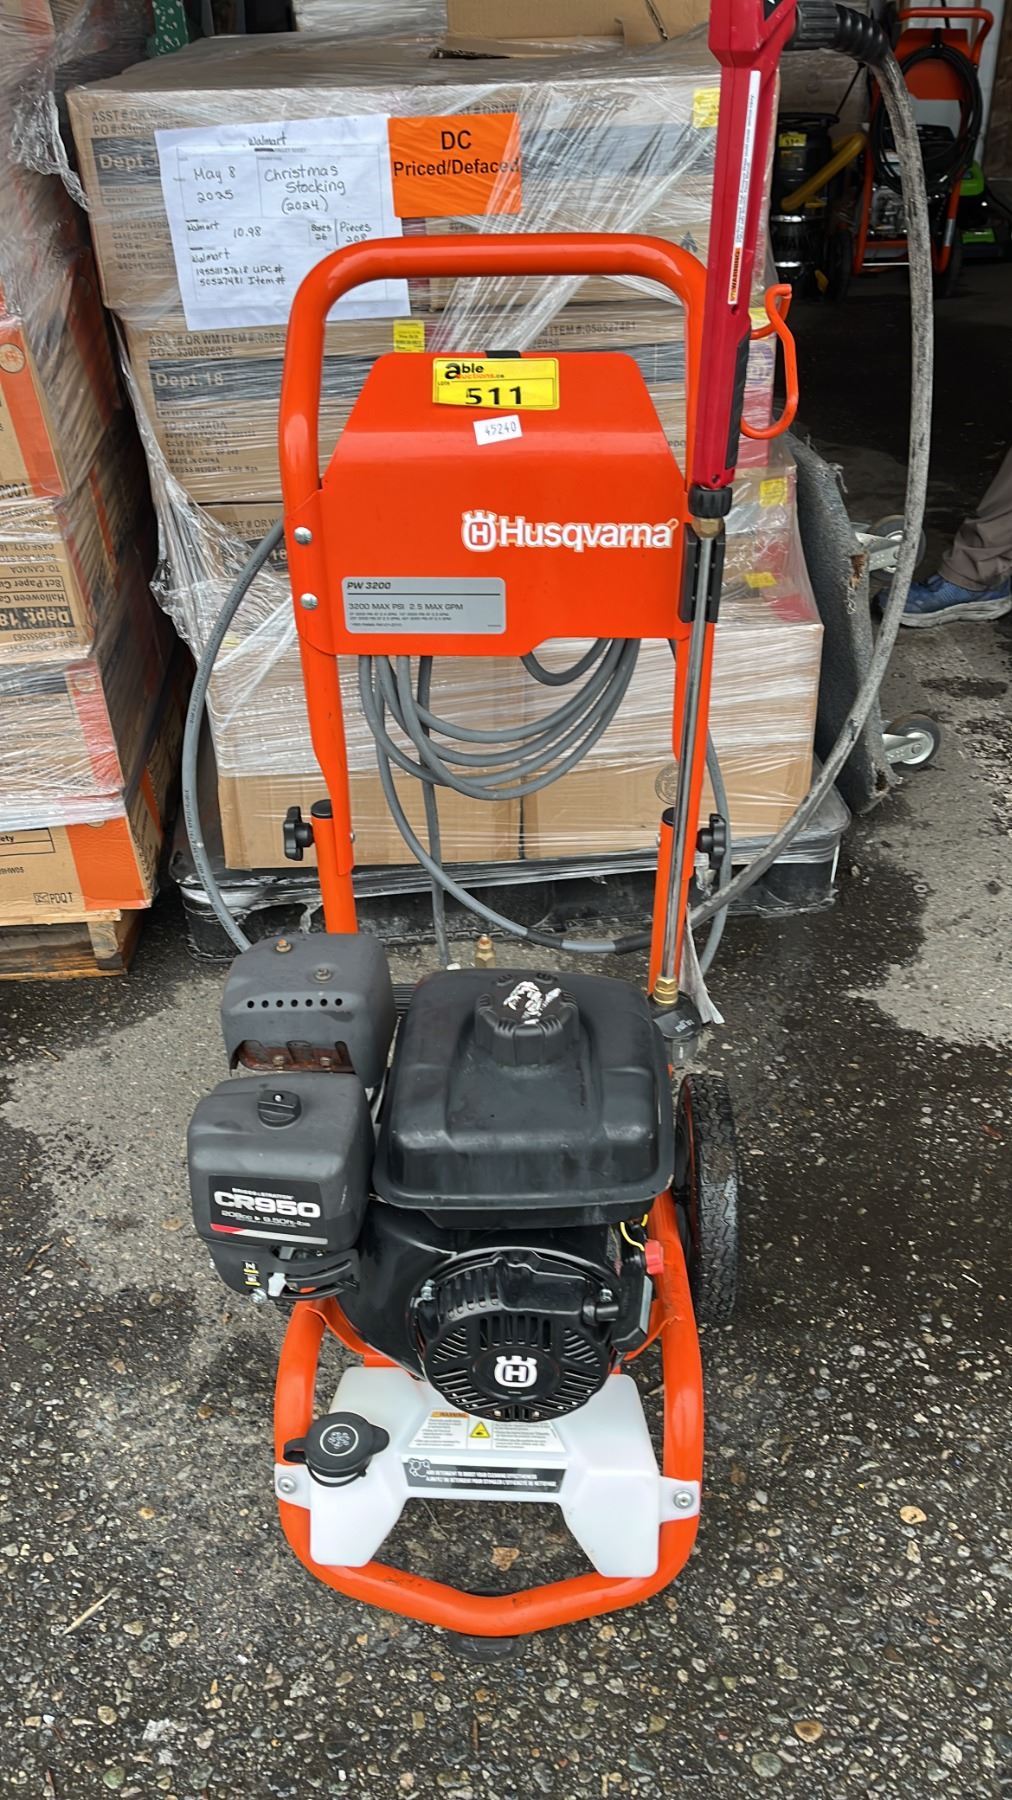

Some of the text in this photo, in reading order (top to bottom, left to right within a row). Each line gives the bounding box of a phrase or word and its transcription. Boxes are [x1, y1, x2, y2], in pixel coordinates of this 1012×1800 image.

[248, 131, 287, 146] Walmart
[441, 130, 472, 150] DC
[264, 164, 338, 182] Christmas
[393, 157, 520, 176] Priced/Defaced
[193, 166, 236, 184] May 8
[285, 179, 346, 196] Stocking
[196, 189, 235, 204] 2025
[281, 195, 329, 215] (2024)
[187, 220, 220, 232] Walmart
[233, 226, 262, 239] 10.98
[340, 221, 373, 233] Pieces
[465, 386, 522, 405] 511
[499, 515, 675, 553] Husqvarna
[9, 565, 45, 574] CANADA
[14, 579, 44, 588] Paper
[347, 582, 392, 590] PW 3200
[13, 593, 66, 602] Halloween
[349, 603, 370, 611] 3200
[392, 603, 405, 611] PSI
[425, 603, 443, 611] MAX
[445, 603, 464, 611] GPM
[23, 608, 71, 624] Dept.
[213, 1190, 321, 1218] CR950
